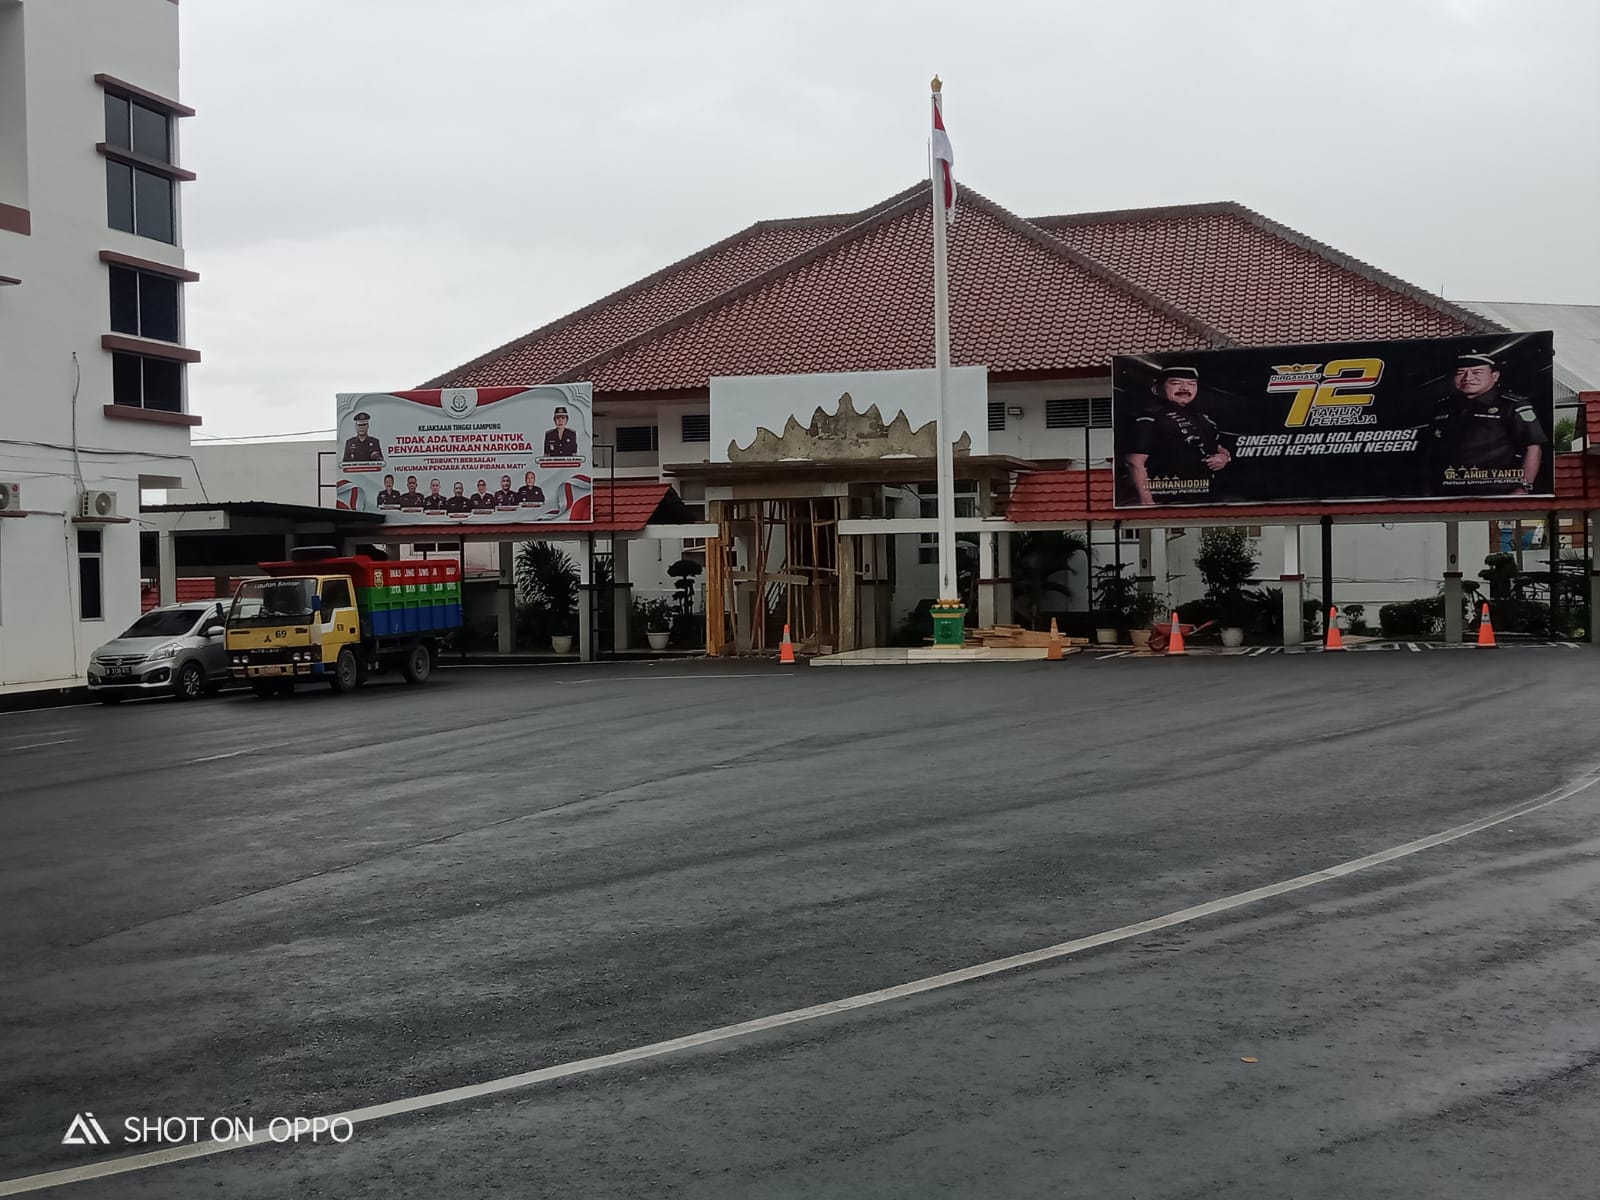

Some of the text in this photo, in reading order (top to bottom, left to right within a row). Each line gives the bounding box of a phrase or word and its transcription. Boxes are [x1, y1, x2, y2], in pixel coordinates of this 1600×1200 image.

[1312, 406, 1362, 417] TAHUN
[1310, 415, 1377, 427] PERSAJA
[418, 424, 452, 432] KEJAKSAAN
[472, 423, 501, 431] LAMPUNG
[396, 433, 524, 444] TIDAK ADA TEMPAT UNTUK
[1236, 429, 1418, 447] SINERGI DAN KOLABORASI
[388, 442, 533, 454] PENYALAHGUNAAN NARKOBA
[1235, 441, 1418, 458] UNTUK KEMAJUAN NEGERI
[1464, 470, 1488, 479] AMIR
[1491, 469, 1524, 478] YANTO
[275, 630, 287, 638] 69
